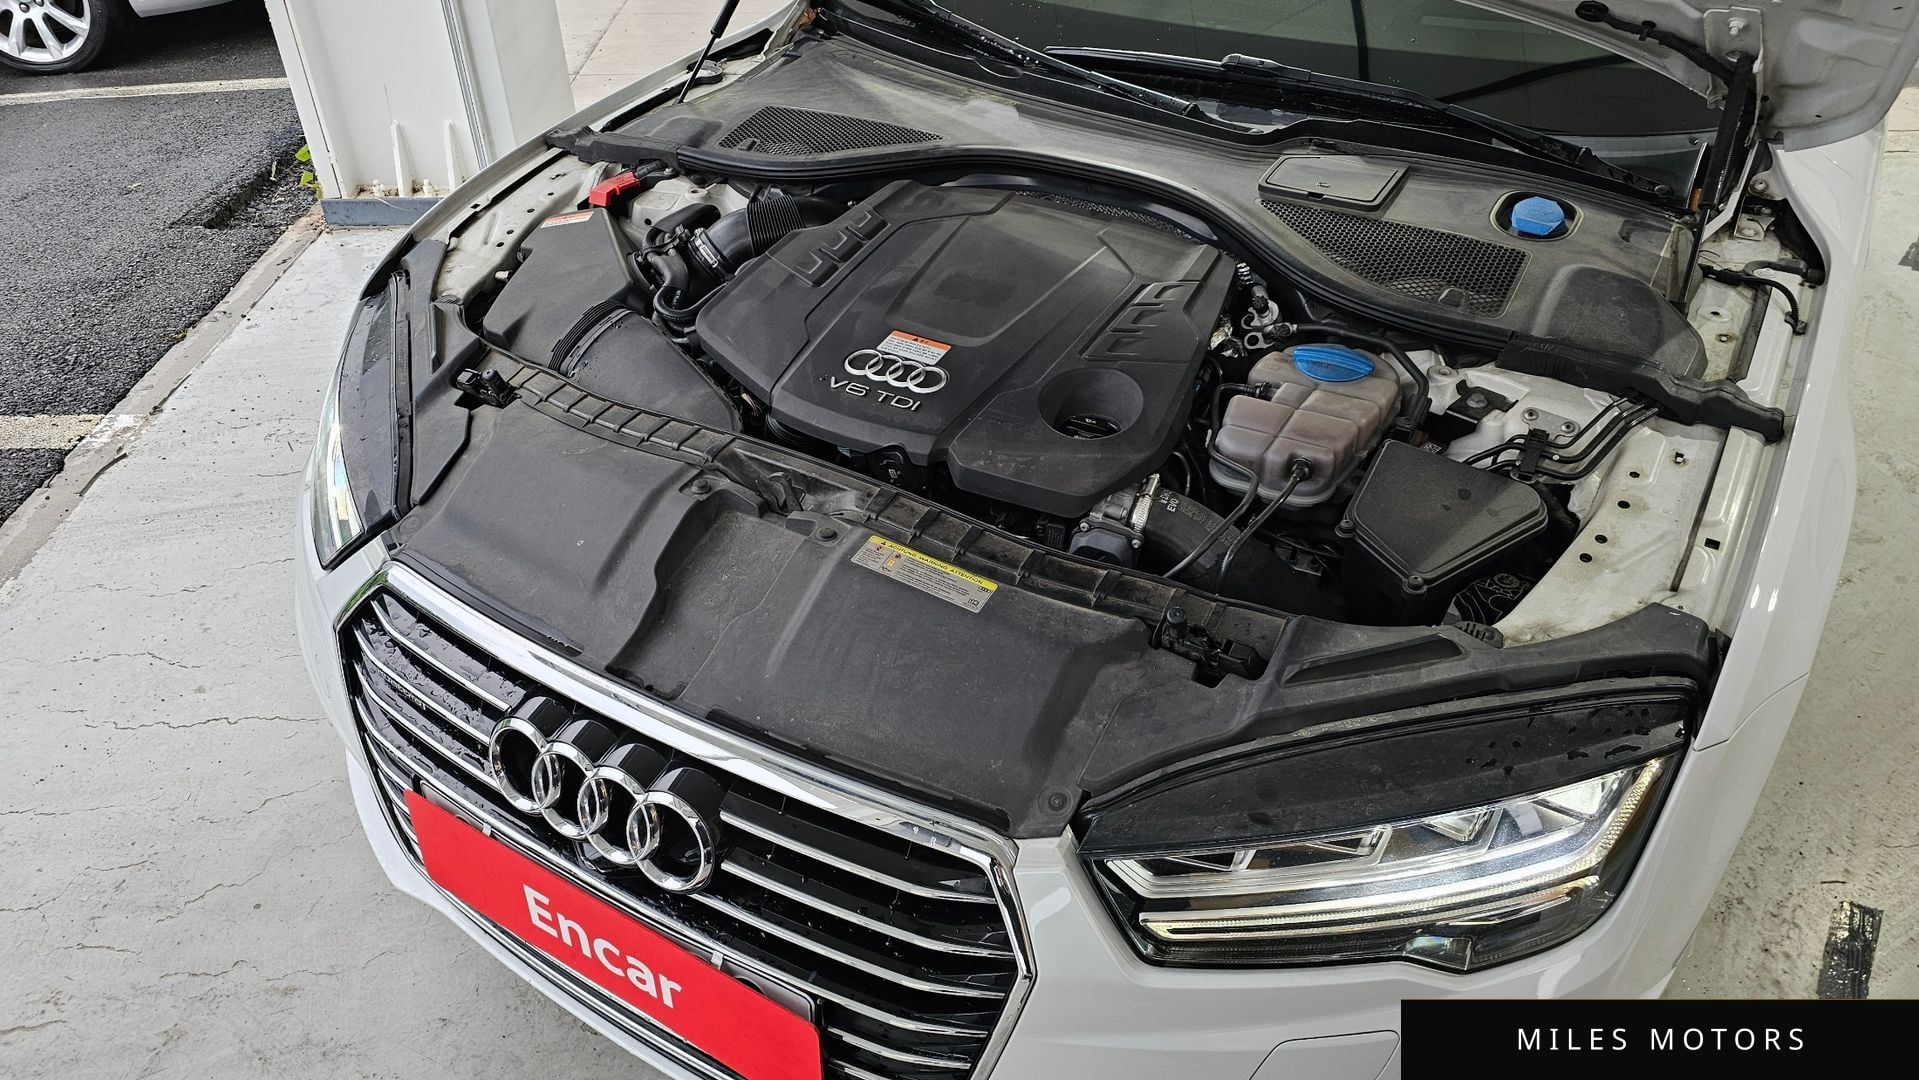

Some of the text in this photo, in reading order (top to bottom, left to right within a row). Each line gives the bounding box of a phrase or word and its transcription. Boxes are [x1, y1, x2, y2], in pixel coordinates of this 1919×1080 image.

[830, 376, 921, 412] V6 TDI
[919, 556, 948, 570] WARNING
[949, 569, 983, 585] ATTENTION
[523, 885, 682, 1009] Encar
